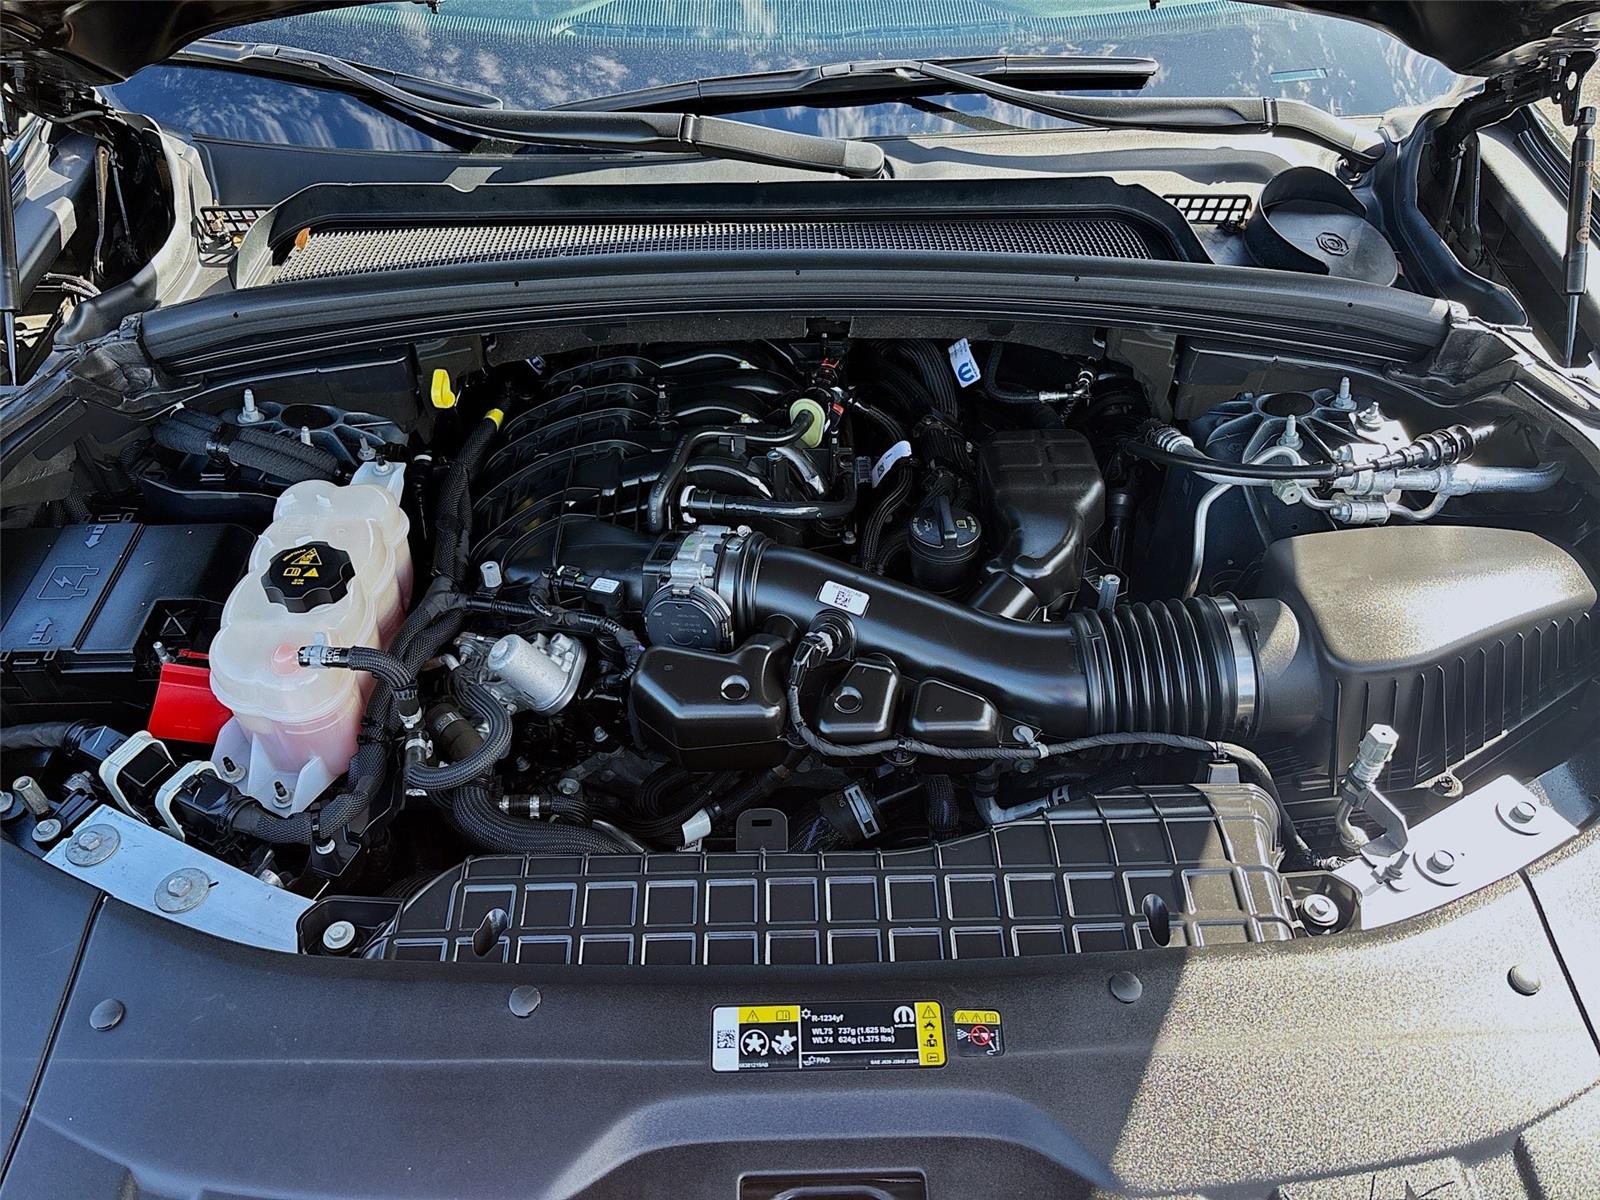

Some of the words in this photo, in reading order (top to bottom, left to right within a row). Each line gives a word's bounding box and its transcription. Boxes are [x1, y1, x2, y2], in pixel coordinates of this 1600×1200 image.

[811, 1014, 844, 1023] R-1234yf
[811, 1027, 834, 1036] WL75
[837, 1027, 856, 1036] 737g
[856, 1026, 879, 1035] (1.625
[879, 1026, 895, 1035] lbs)
[811, 1036, 834, 1044] WL74
[838, 1036, 857, 1045] 624g
[857, 1035, 880, 1044] (1.375
[880, 1035, 895, 1044] lbs)
